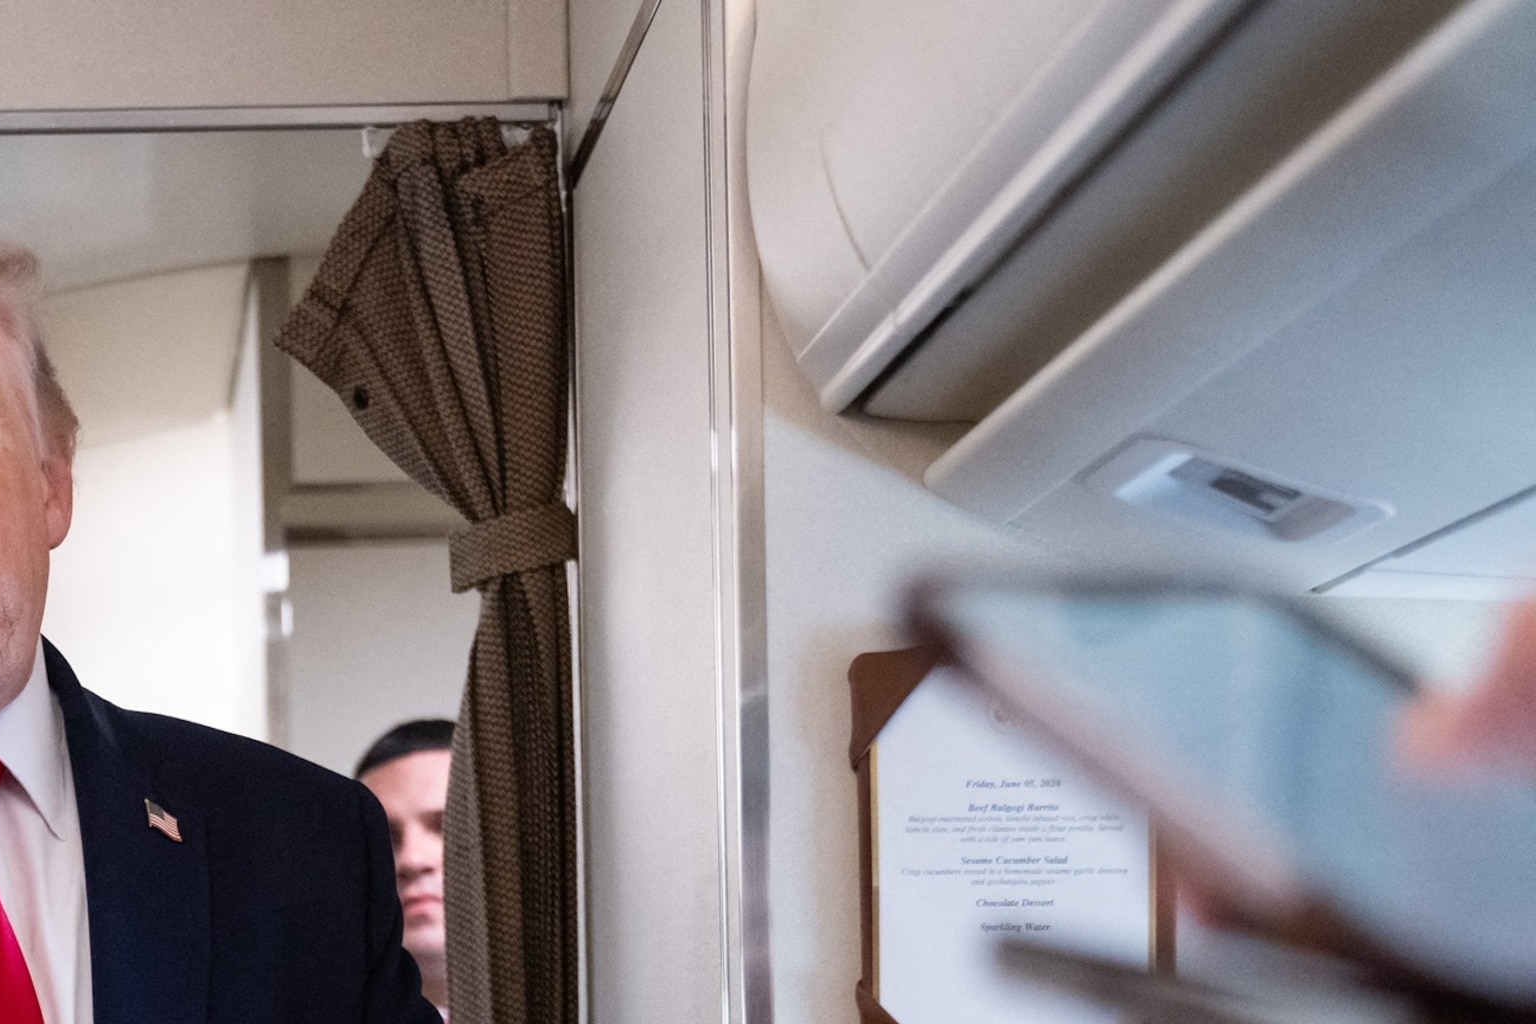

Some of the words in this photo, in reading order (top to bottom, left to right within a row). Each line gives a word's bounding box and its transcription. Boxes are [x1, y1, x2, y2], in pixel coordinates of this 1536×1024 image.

[965, 779, 997, 790] Friday,
[999, 779, 1021, 788] June
[968, 803, 989, 813] Beef
[990, 803, 1024, 814] Bulgogi
[1027, 803, 1060, 812] Burrito
[960, 855, 993, 865] Sesame
[995, 855, 1042, 865] Cucumber
[1043, 855, 1069, 865] Salad
[976, 898, 1020, 908] Chocolate
[1021, 898, 1054, 907] Dessert
[980, 921, 1022, 933] Sparkling
[1024, 922, 1052, 932] Water
